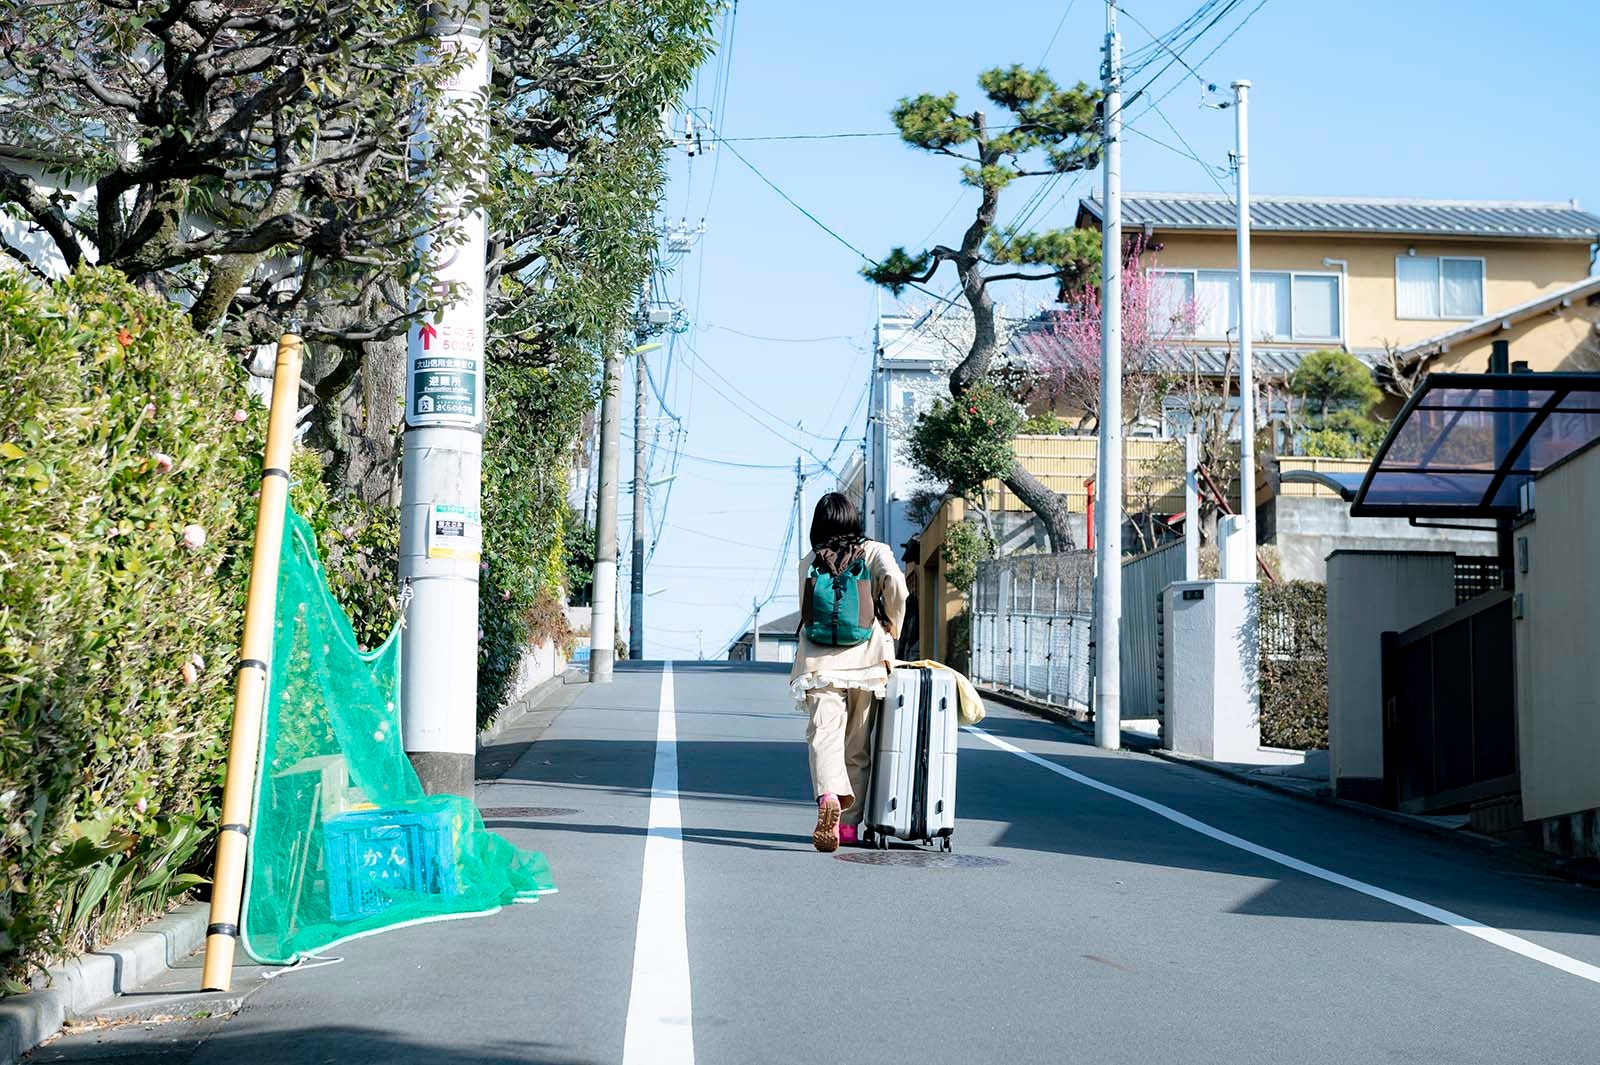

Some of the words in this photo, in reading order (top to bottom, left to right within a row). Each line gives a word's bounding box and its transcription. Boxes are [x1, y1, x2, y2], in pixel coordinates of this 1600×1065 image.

[428, 375, 462, 387] 避難所
[361, 843, 407, 867] かん
